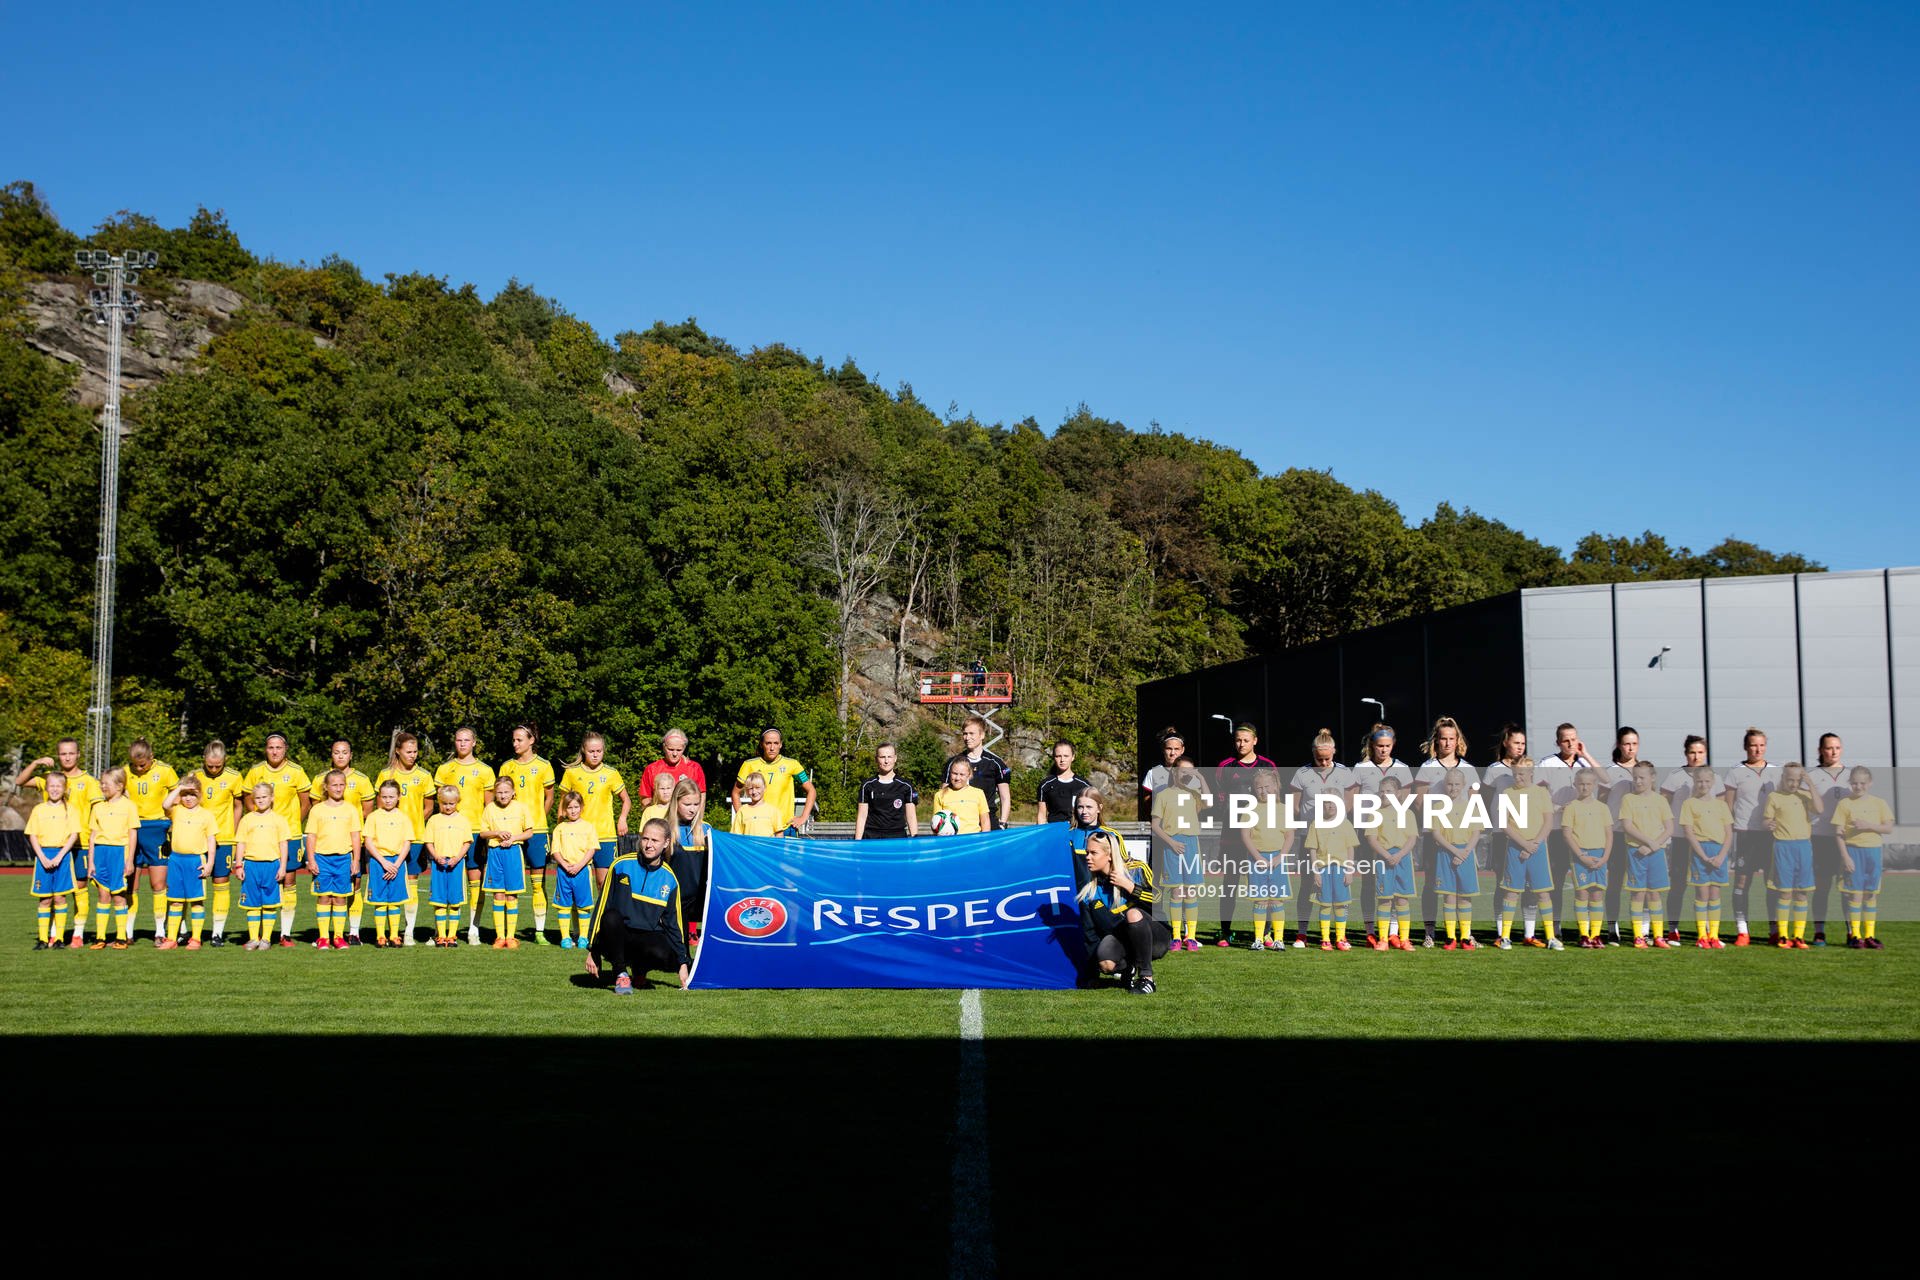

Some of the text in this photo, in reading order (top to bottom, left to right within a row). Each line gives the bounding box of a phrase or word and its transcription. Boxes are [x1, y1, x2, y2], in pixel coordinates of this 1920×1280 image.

[458, 775, 465, 788] 4
[519, 775, 526, 788] 3
[767, 772, 774, 785] 7
[137, 782, 148, 795] 10
[206, 786, 213, 799] 9
[401, 783, 408, 796] 5
[587, 781, 595, 794] 2
[225, 855, 232, 869] 9
[738, 899, 776, 910] UEFA
[813, 886, 1071, 931] RESPECT
